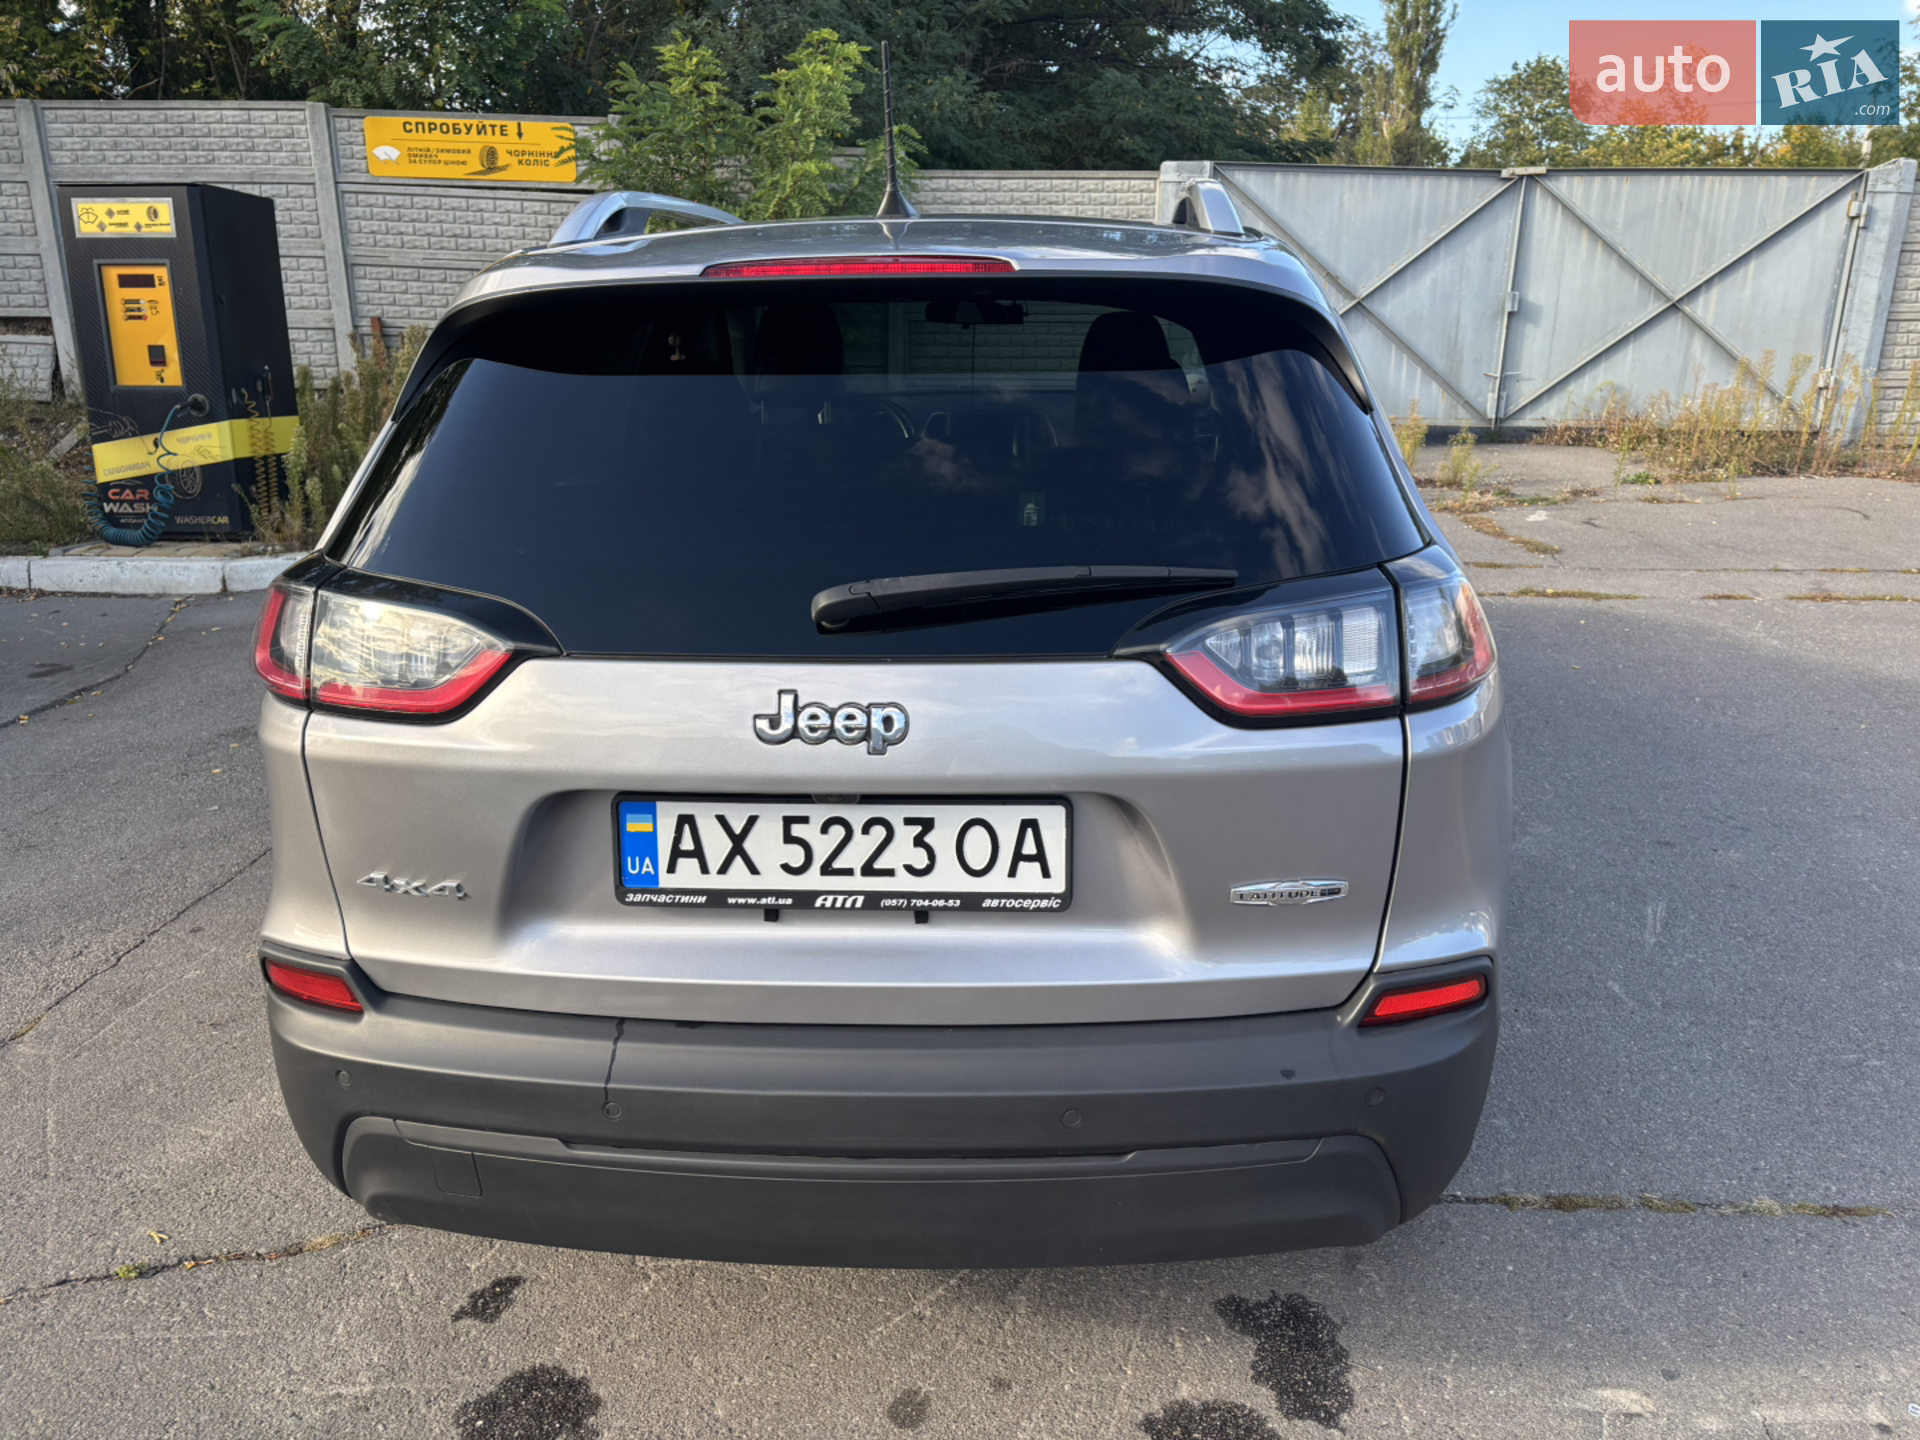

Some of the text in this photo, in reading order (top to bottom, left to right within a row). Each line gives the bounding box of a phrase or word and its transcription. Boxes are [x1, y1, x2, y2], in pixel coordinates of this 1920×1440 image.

[402, 121, 509, 137] СПРОБУЙТЕ
[506, 149, 558, 159] ЧОРНІНН
[517, 158, 551, 167] КОЛІС
[108, 488, 150, 500] CAR
[103, 502, 158, 513] WASH
[754, 689, 909, 755] Jeep
[666, 813, 1053, 879] AX 5223 OA
[626, 856, 655, 875] UA
[625, 893, 708, 904] запчастини
[880, 898, 961, 909] (057) 704-06-53
[982, 897, 1062, 911] автосервіс
